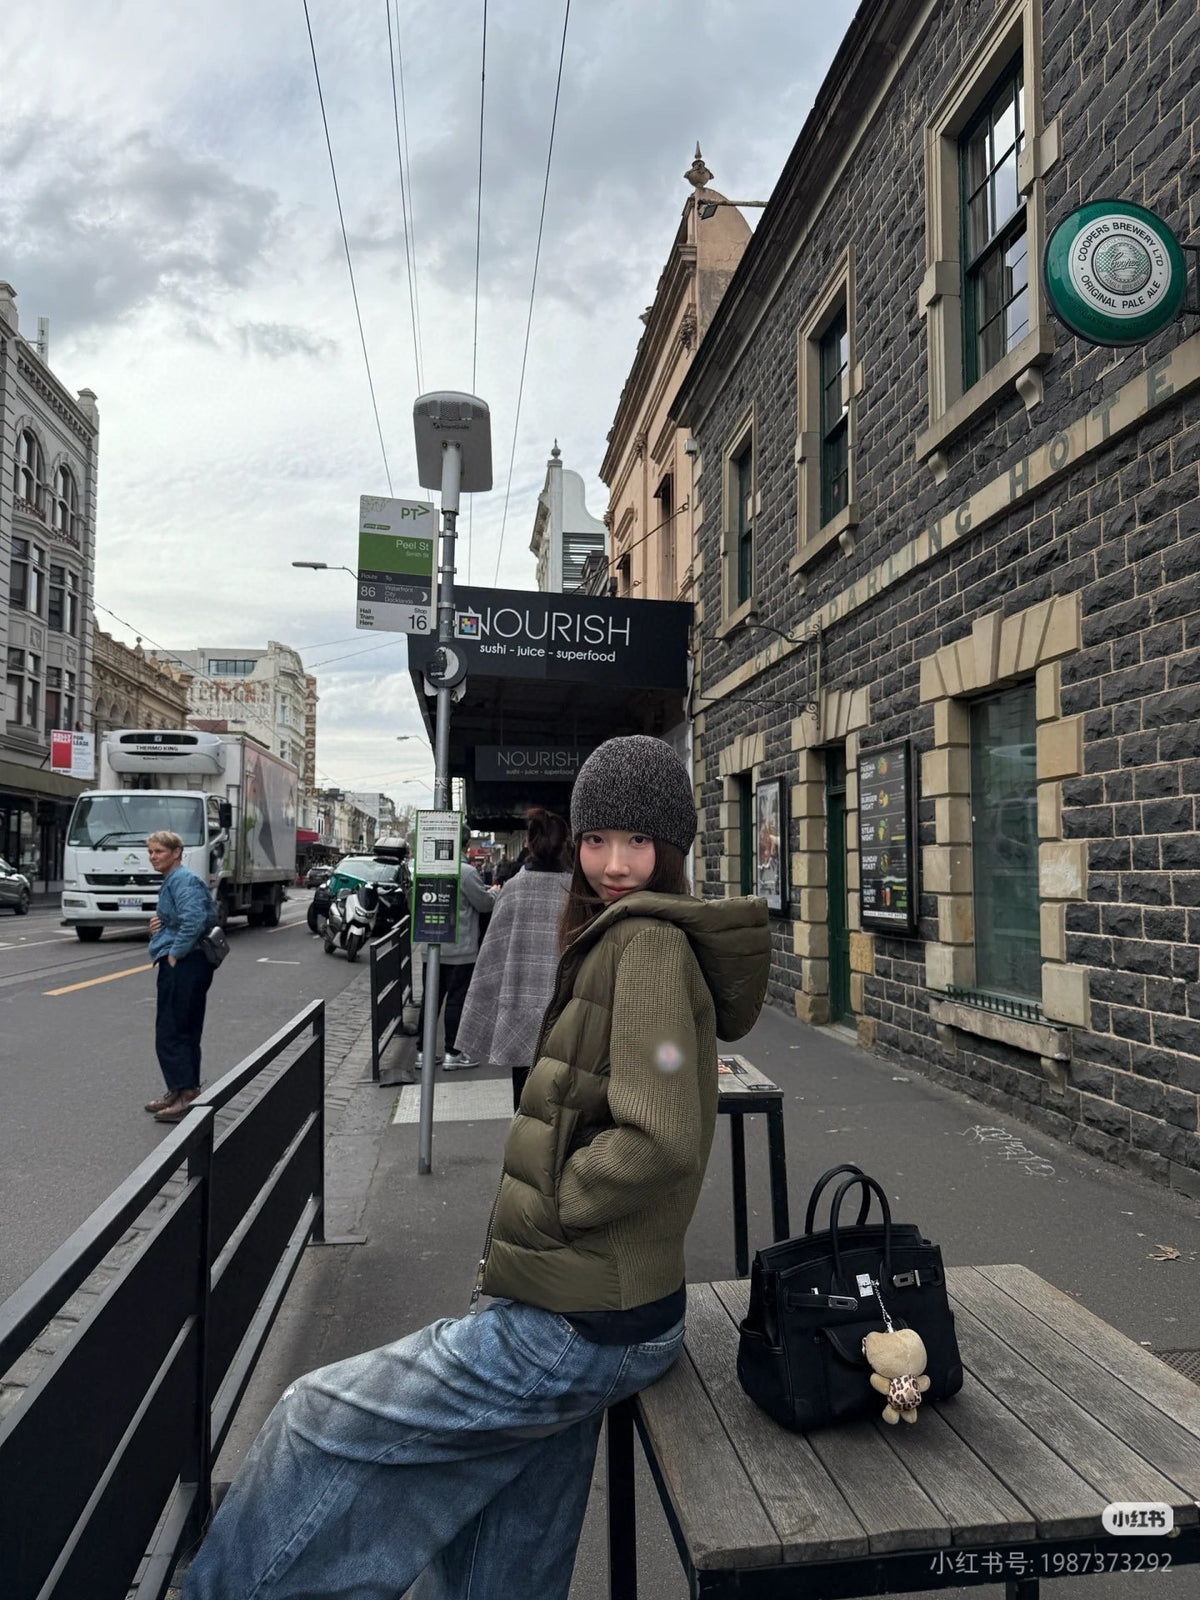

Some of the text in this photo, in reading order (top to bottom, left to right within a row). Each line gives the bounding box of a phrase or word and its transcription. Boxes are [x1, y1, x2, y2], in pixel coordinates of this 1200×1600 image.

[1078, 224, 1111, 262] COOPERS
[1112, 222, 1156, 247] BREWERY
[1152, 248, 1164, 267] LTD
[1081, 275, 1161, 309] ORIGINAL PALE ALE
[395, 540, 430, 552] Peel St
[360, 585, 376, 597] 86
[384, 585, 414, 593] Waterfront
[384, 591, 396, 599] City
[384, 596, 414, 605] Docklands
[414, 607, 428, 615] Stop
[408, 614, 428, 631] 16
[468, 606, 631, 647] NOURISH
[479, 643, 507, 655] sushi
[517, 645, 545, 658] juice
[556, 650, 616, 663] superfood
[497, 751, 580, 767] NOURISH
